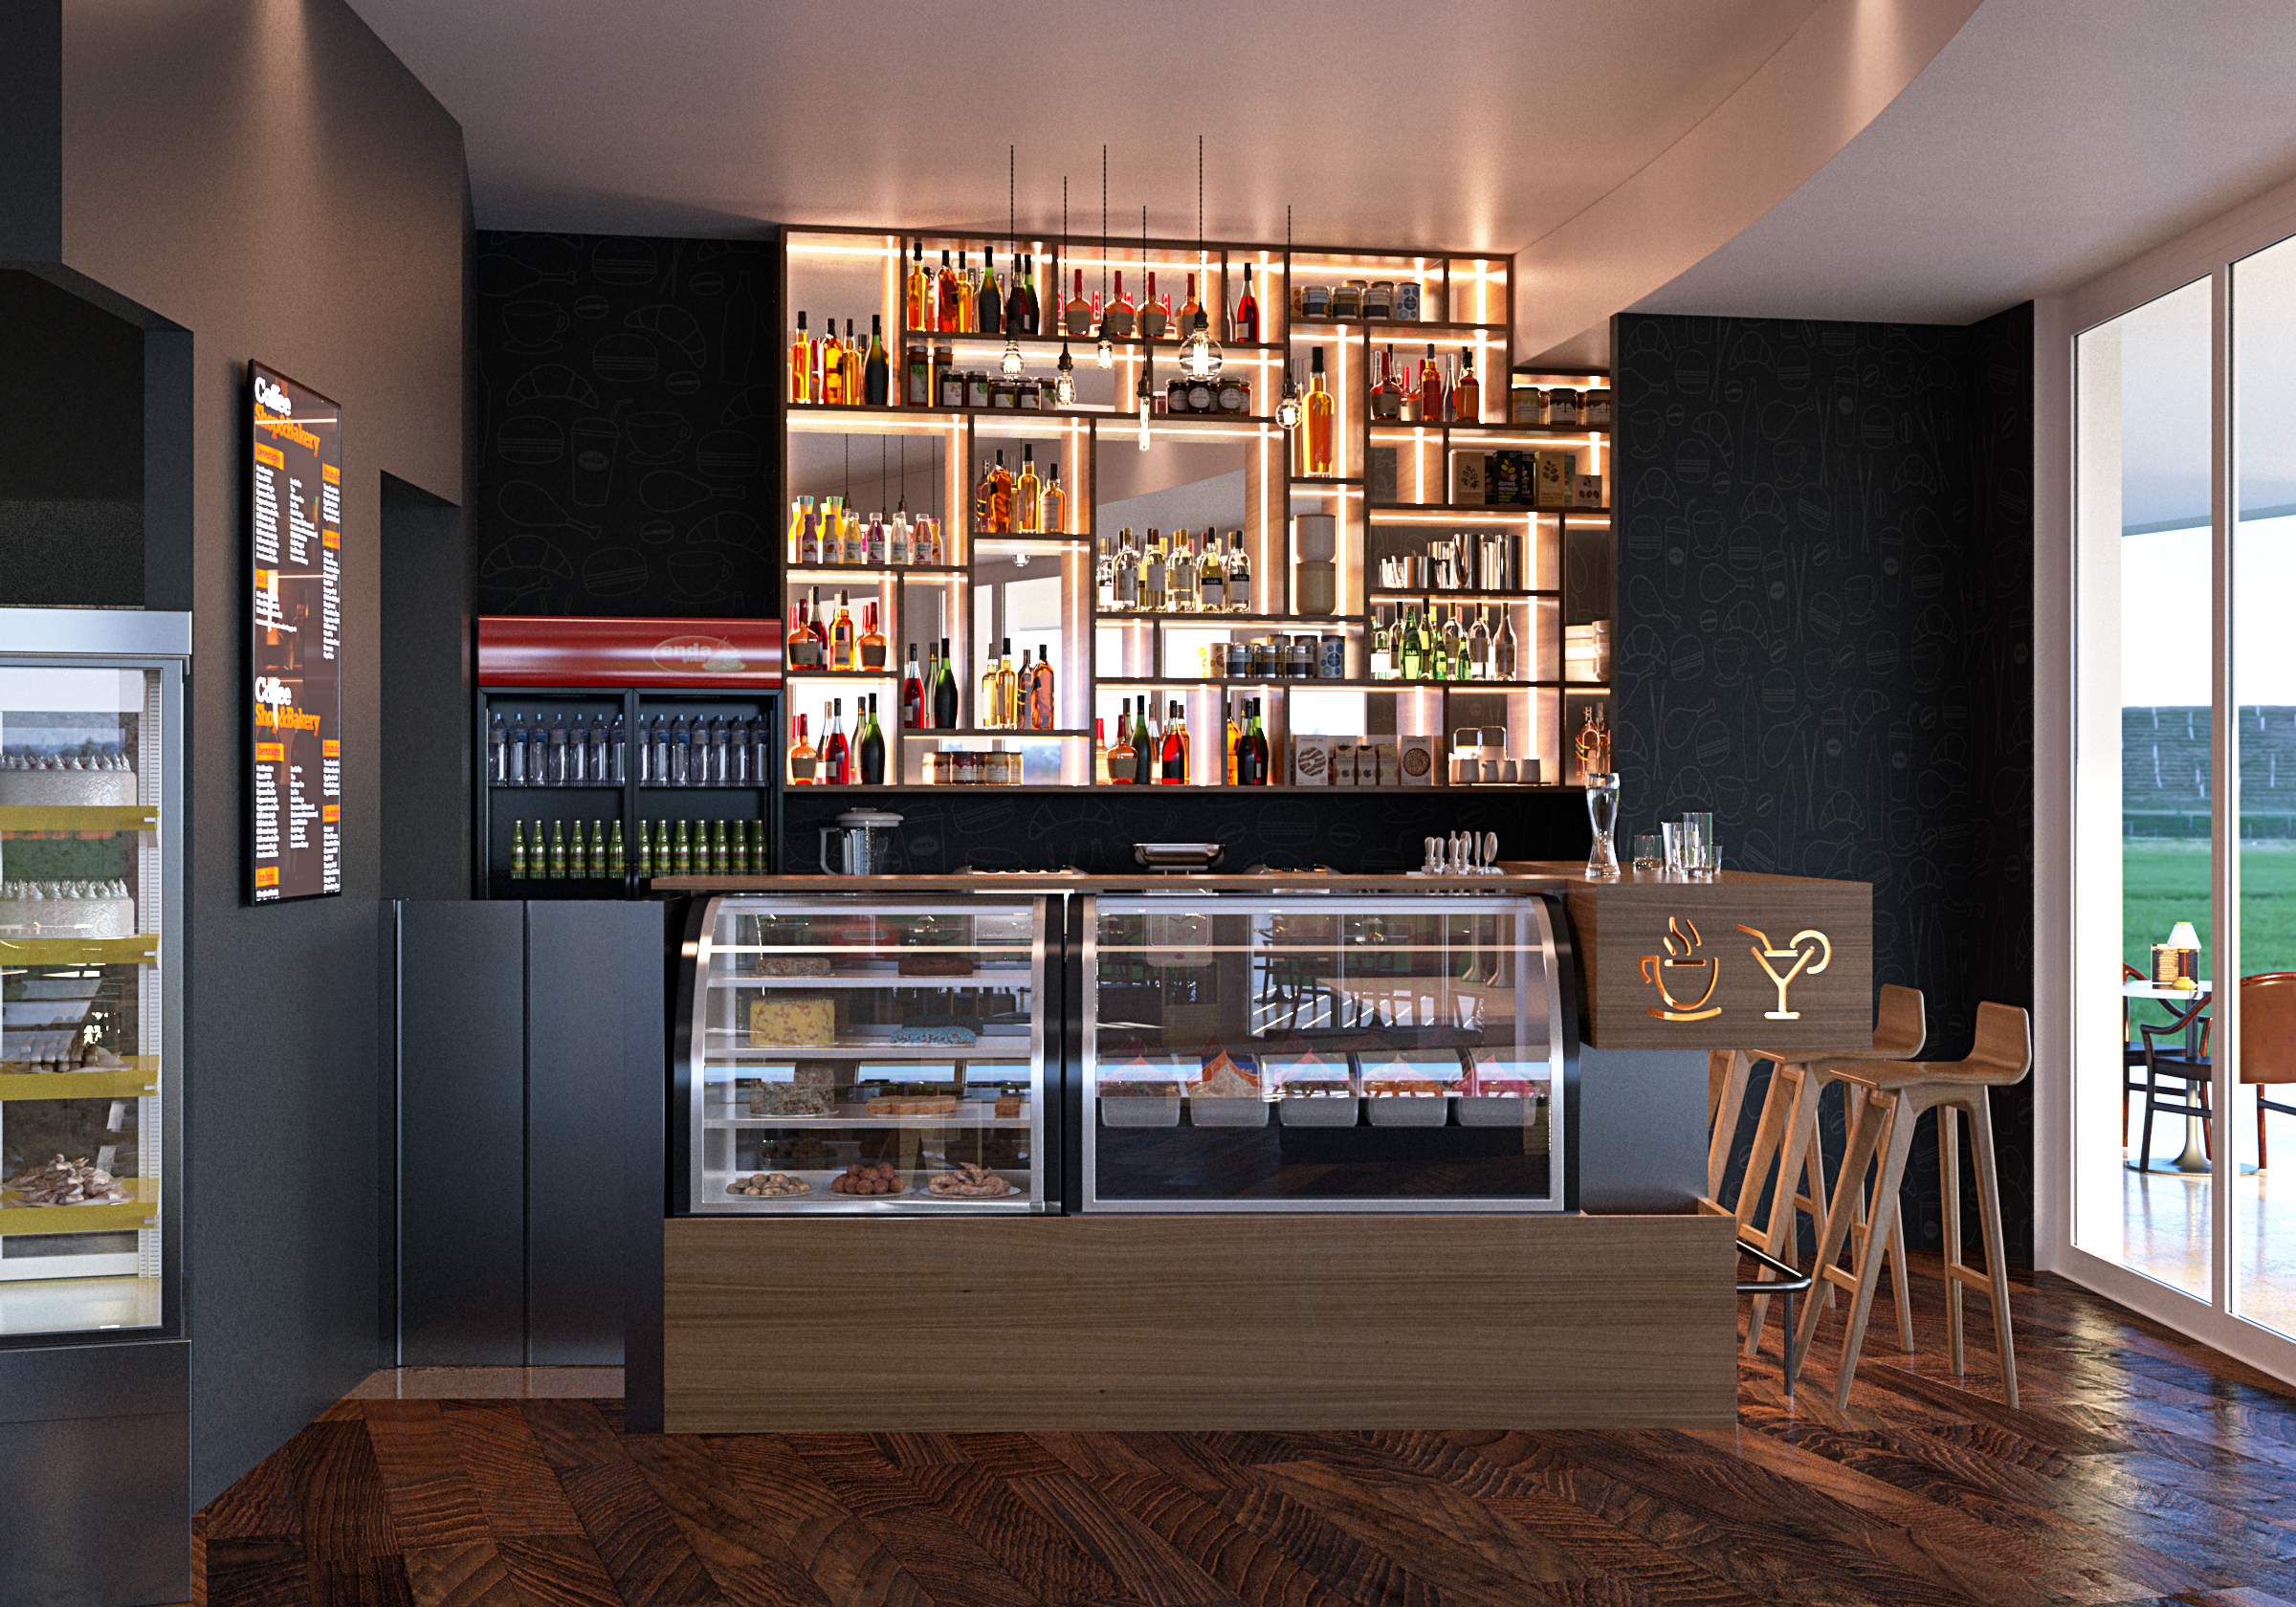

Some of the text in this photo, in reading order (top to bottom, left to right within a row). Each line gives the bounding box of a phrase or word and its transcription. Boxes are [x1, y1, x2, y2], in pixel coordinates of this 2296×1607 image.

[254, 376, 292, 416] Coffee
[254, 402, 320, 457] Shop&Bakery
[661, 642, 712, 656] enda
[254, 675, 292, 706] Coffee
[255, 702, 321, 737] Shop&Bakery
[257, 745, 281, 759] beverages
